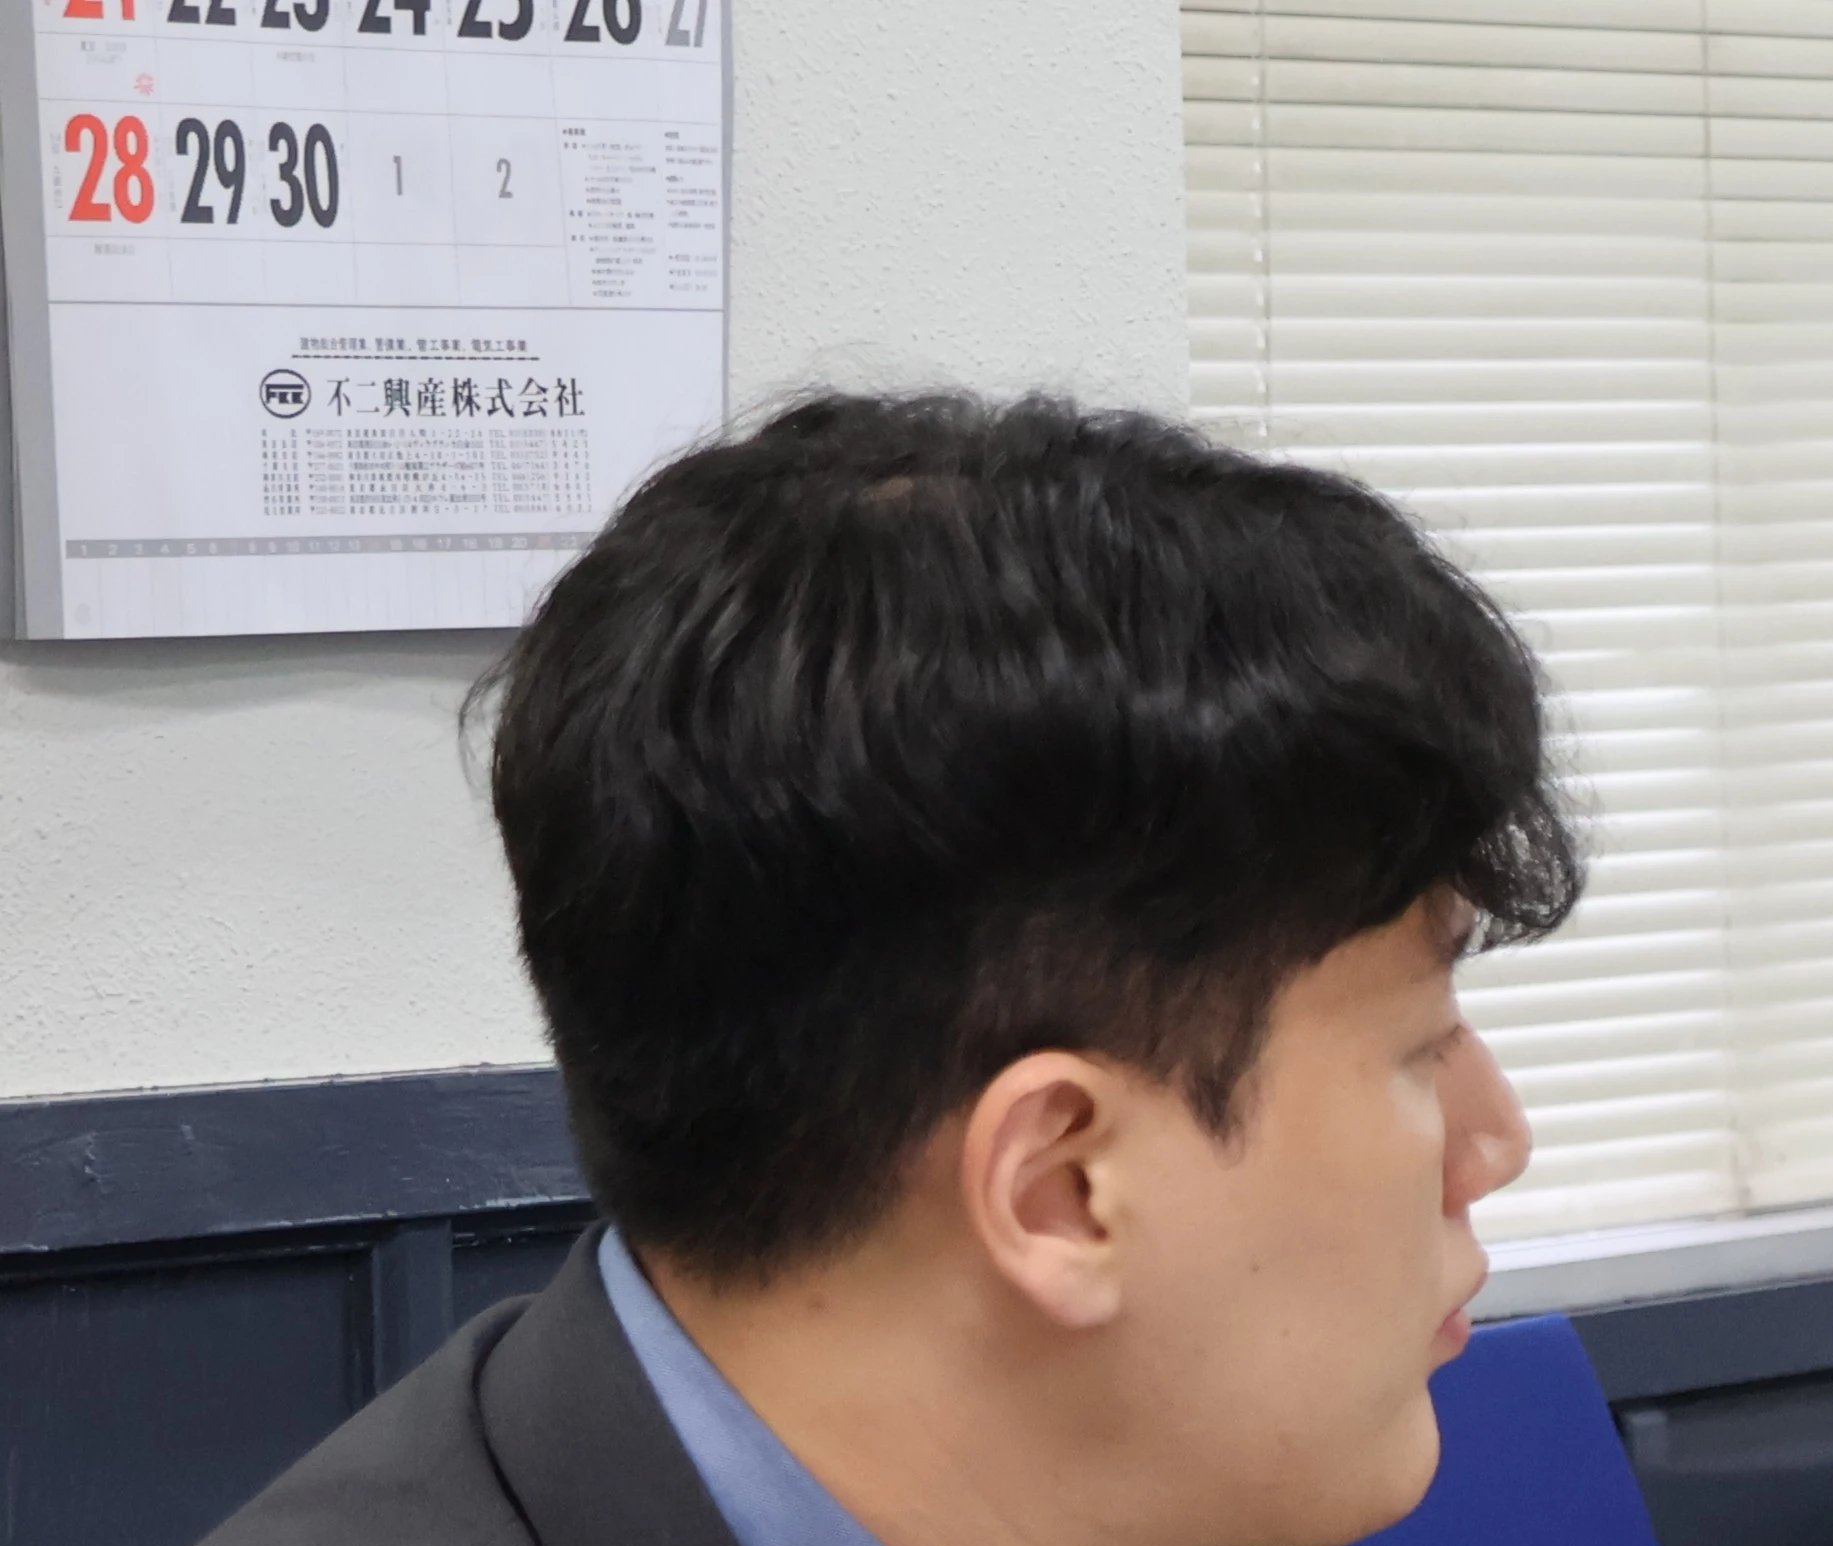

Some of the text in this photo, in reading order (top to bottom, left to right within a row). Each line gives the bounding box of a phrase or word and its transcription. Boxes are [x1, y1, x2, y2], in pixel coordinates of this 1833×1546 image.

[65, 113, 155, 224] 28
[176, 117, 246, 224] 29
[268, 121, 339, 229] 30
[393, 155, 403, 196] 1
[496, 158, 513, 199] 2
[326, 375, 586, 418] 不二興産株式会社
